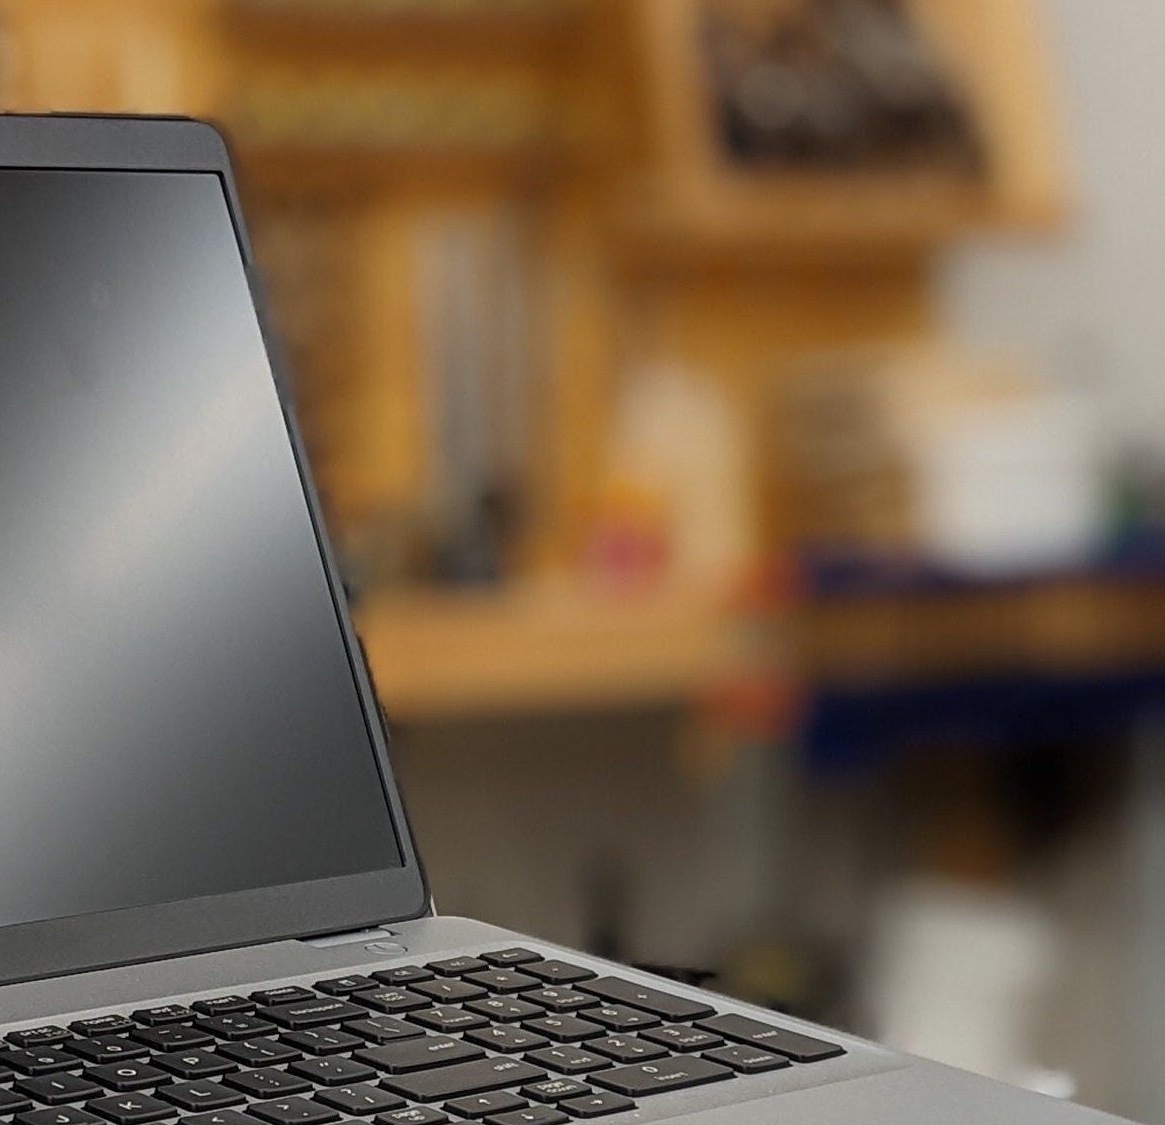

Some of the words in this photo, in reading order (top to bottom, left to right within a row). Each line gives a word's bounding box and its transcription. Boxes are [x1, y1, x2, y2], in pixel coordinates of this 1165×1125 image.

[607, 1038, 626, 1047] 2
[182, 1057, 201, 1066] P
[117, 1068, 137, 1077] O
[189, 1088, 212, 1097] L
[118, 1101, 143, 1111] K
[56, 1114, 71, 1124] J
